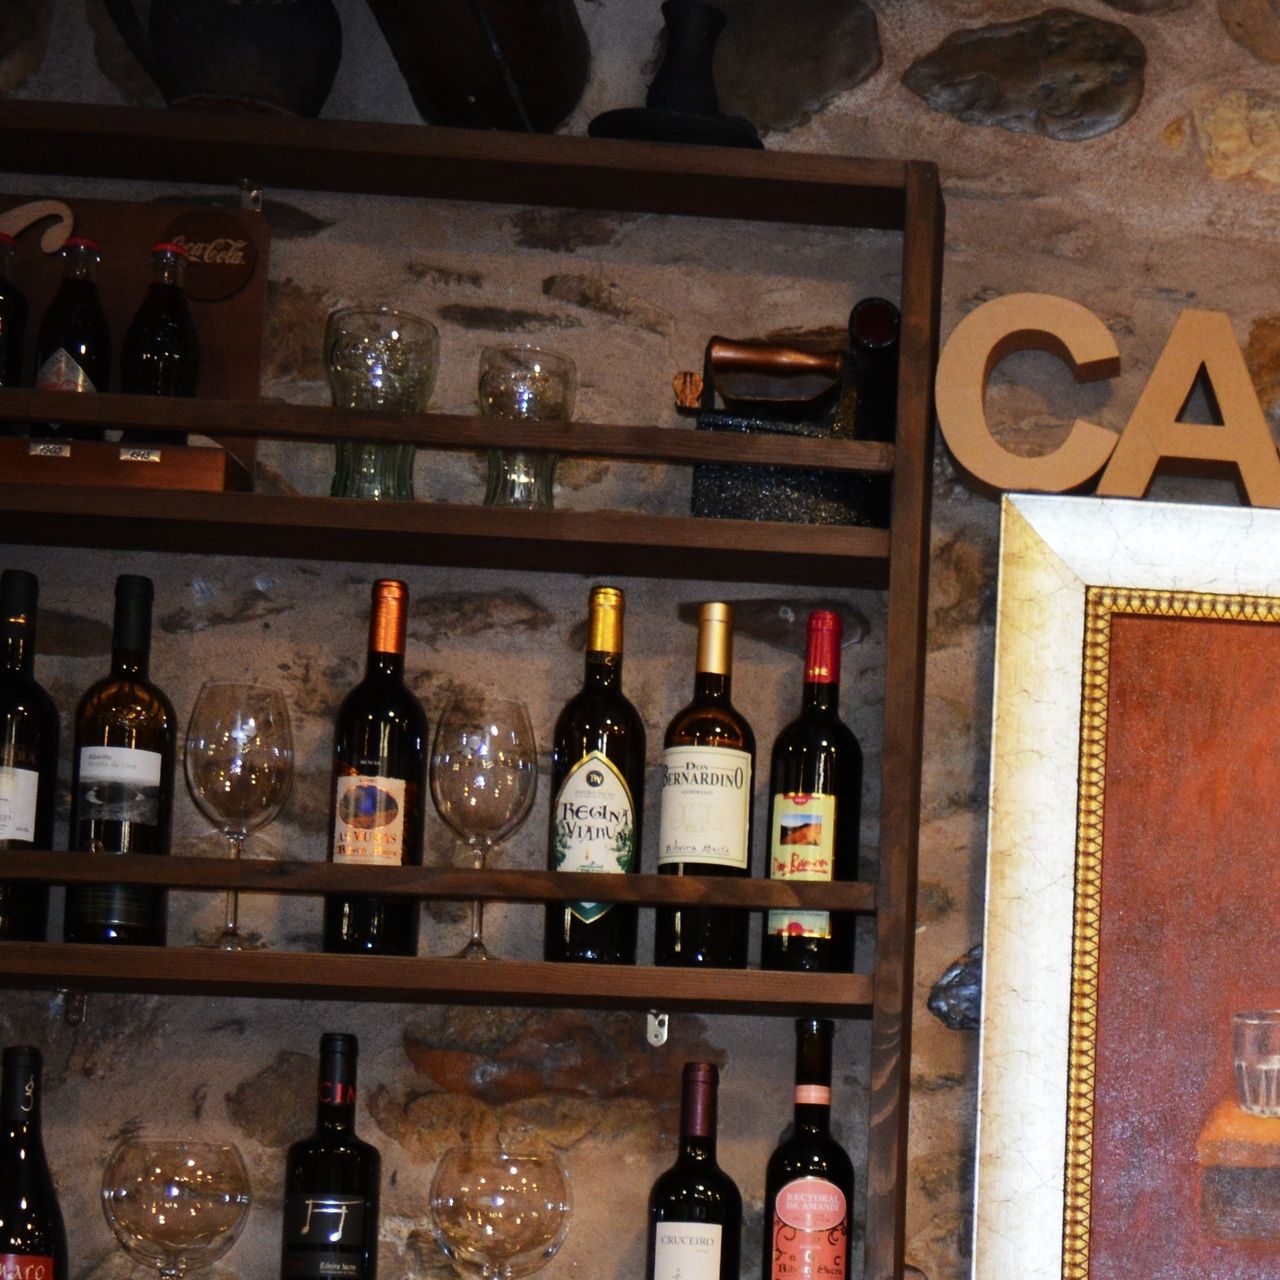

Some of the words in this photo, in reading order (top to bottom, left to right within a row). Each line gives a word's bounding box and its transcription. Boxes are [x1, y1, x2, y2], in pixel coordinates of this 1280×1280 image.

[663, 764, 744, 790] BERNARDINO
[562, 802, 629, 826] REGINA
[661, 1235, 715, 1247] CRUCEIRO
